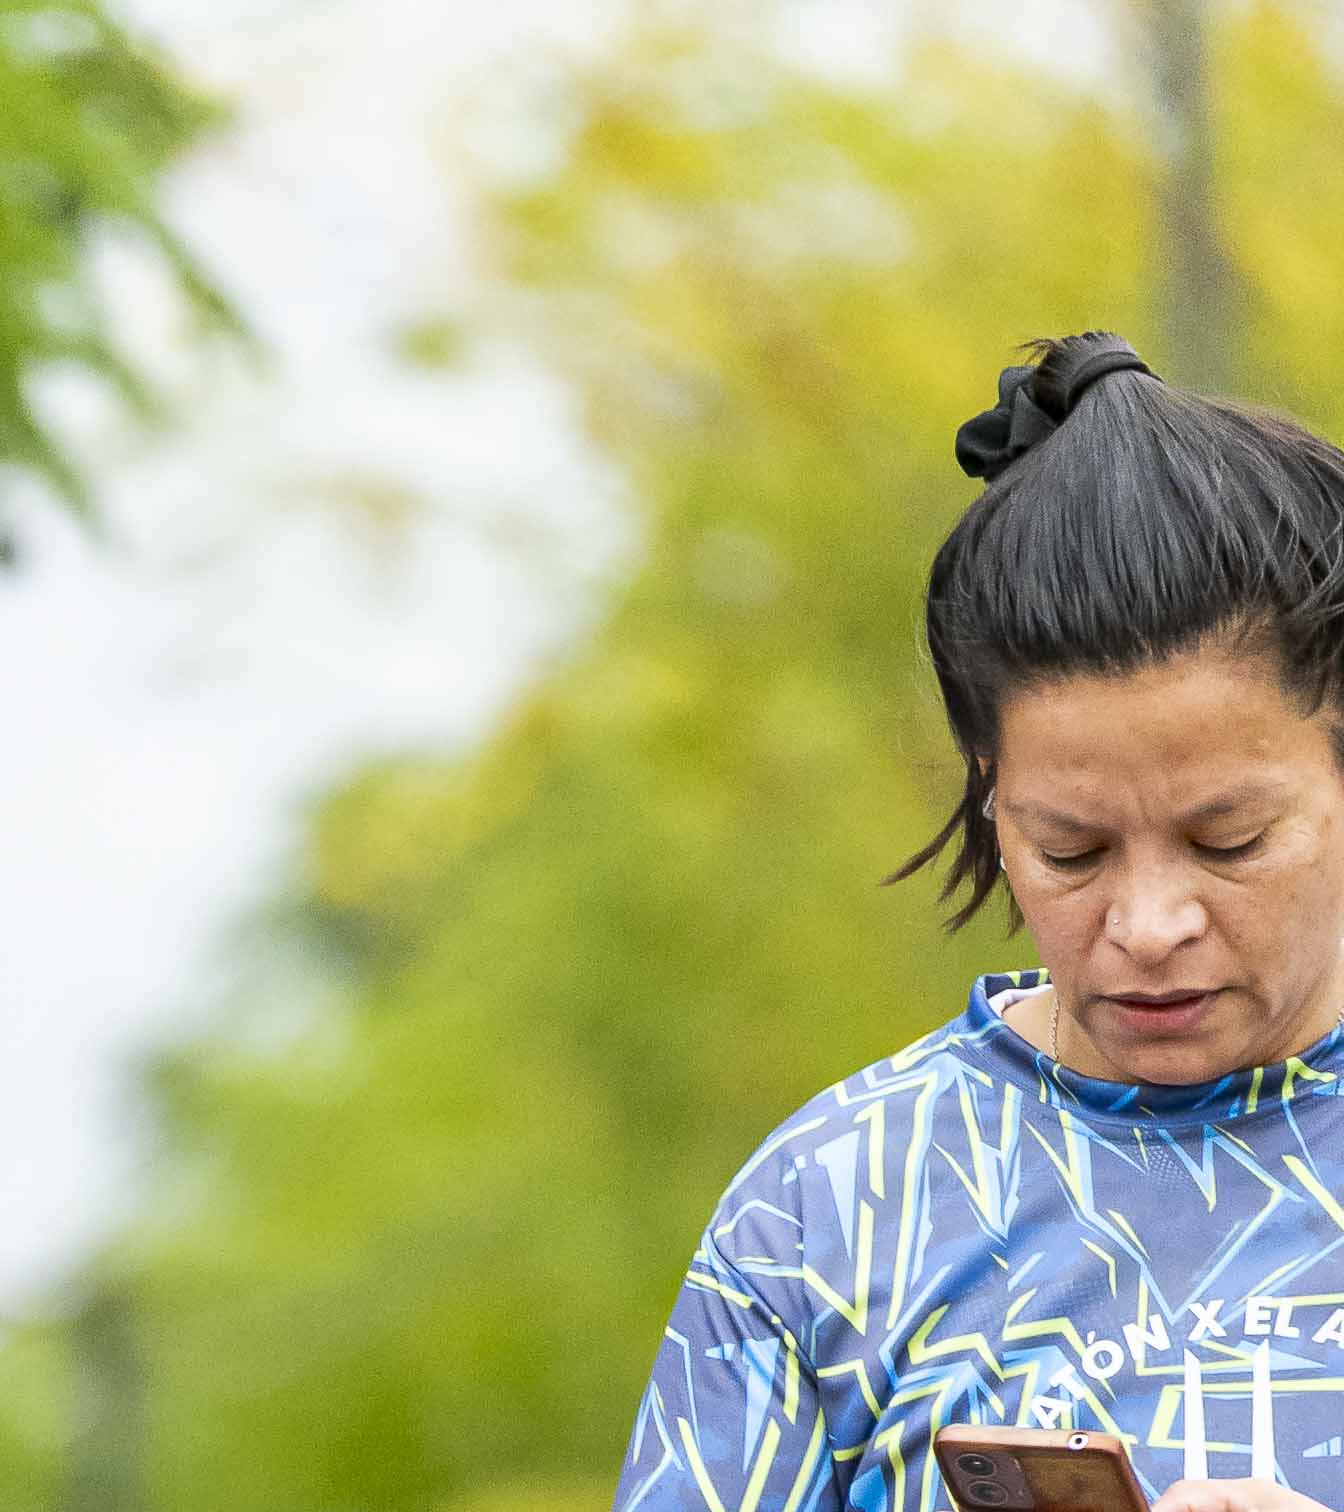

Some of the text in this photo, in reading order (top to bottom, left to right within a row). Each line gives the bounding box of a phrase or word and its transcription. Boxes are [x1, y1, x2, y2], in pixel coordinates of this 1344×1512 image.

[1015, 1313, 1172, 1429] ATÓN
[1187, 1299, 1227, 1340] X
[1243, 1296, 1300, 1339] EL
